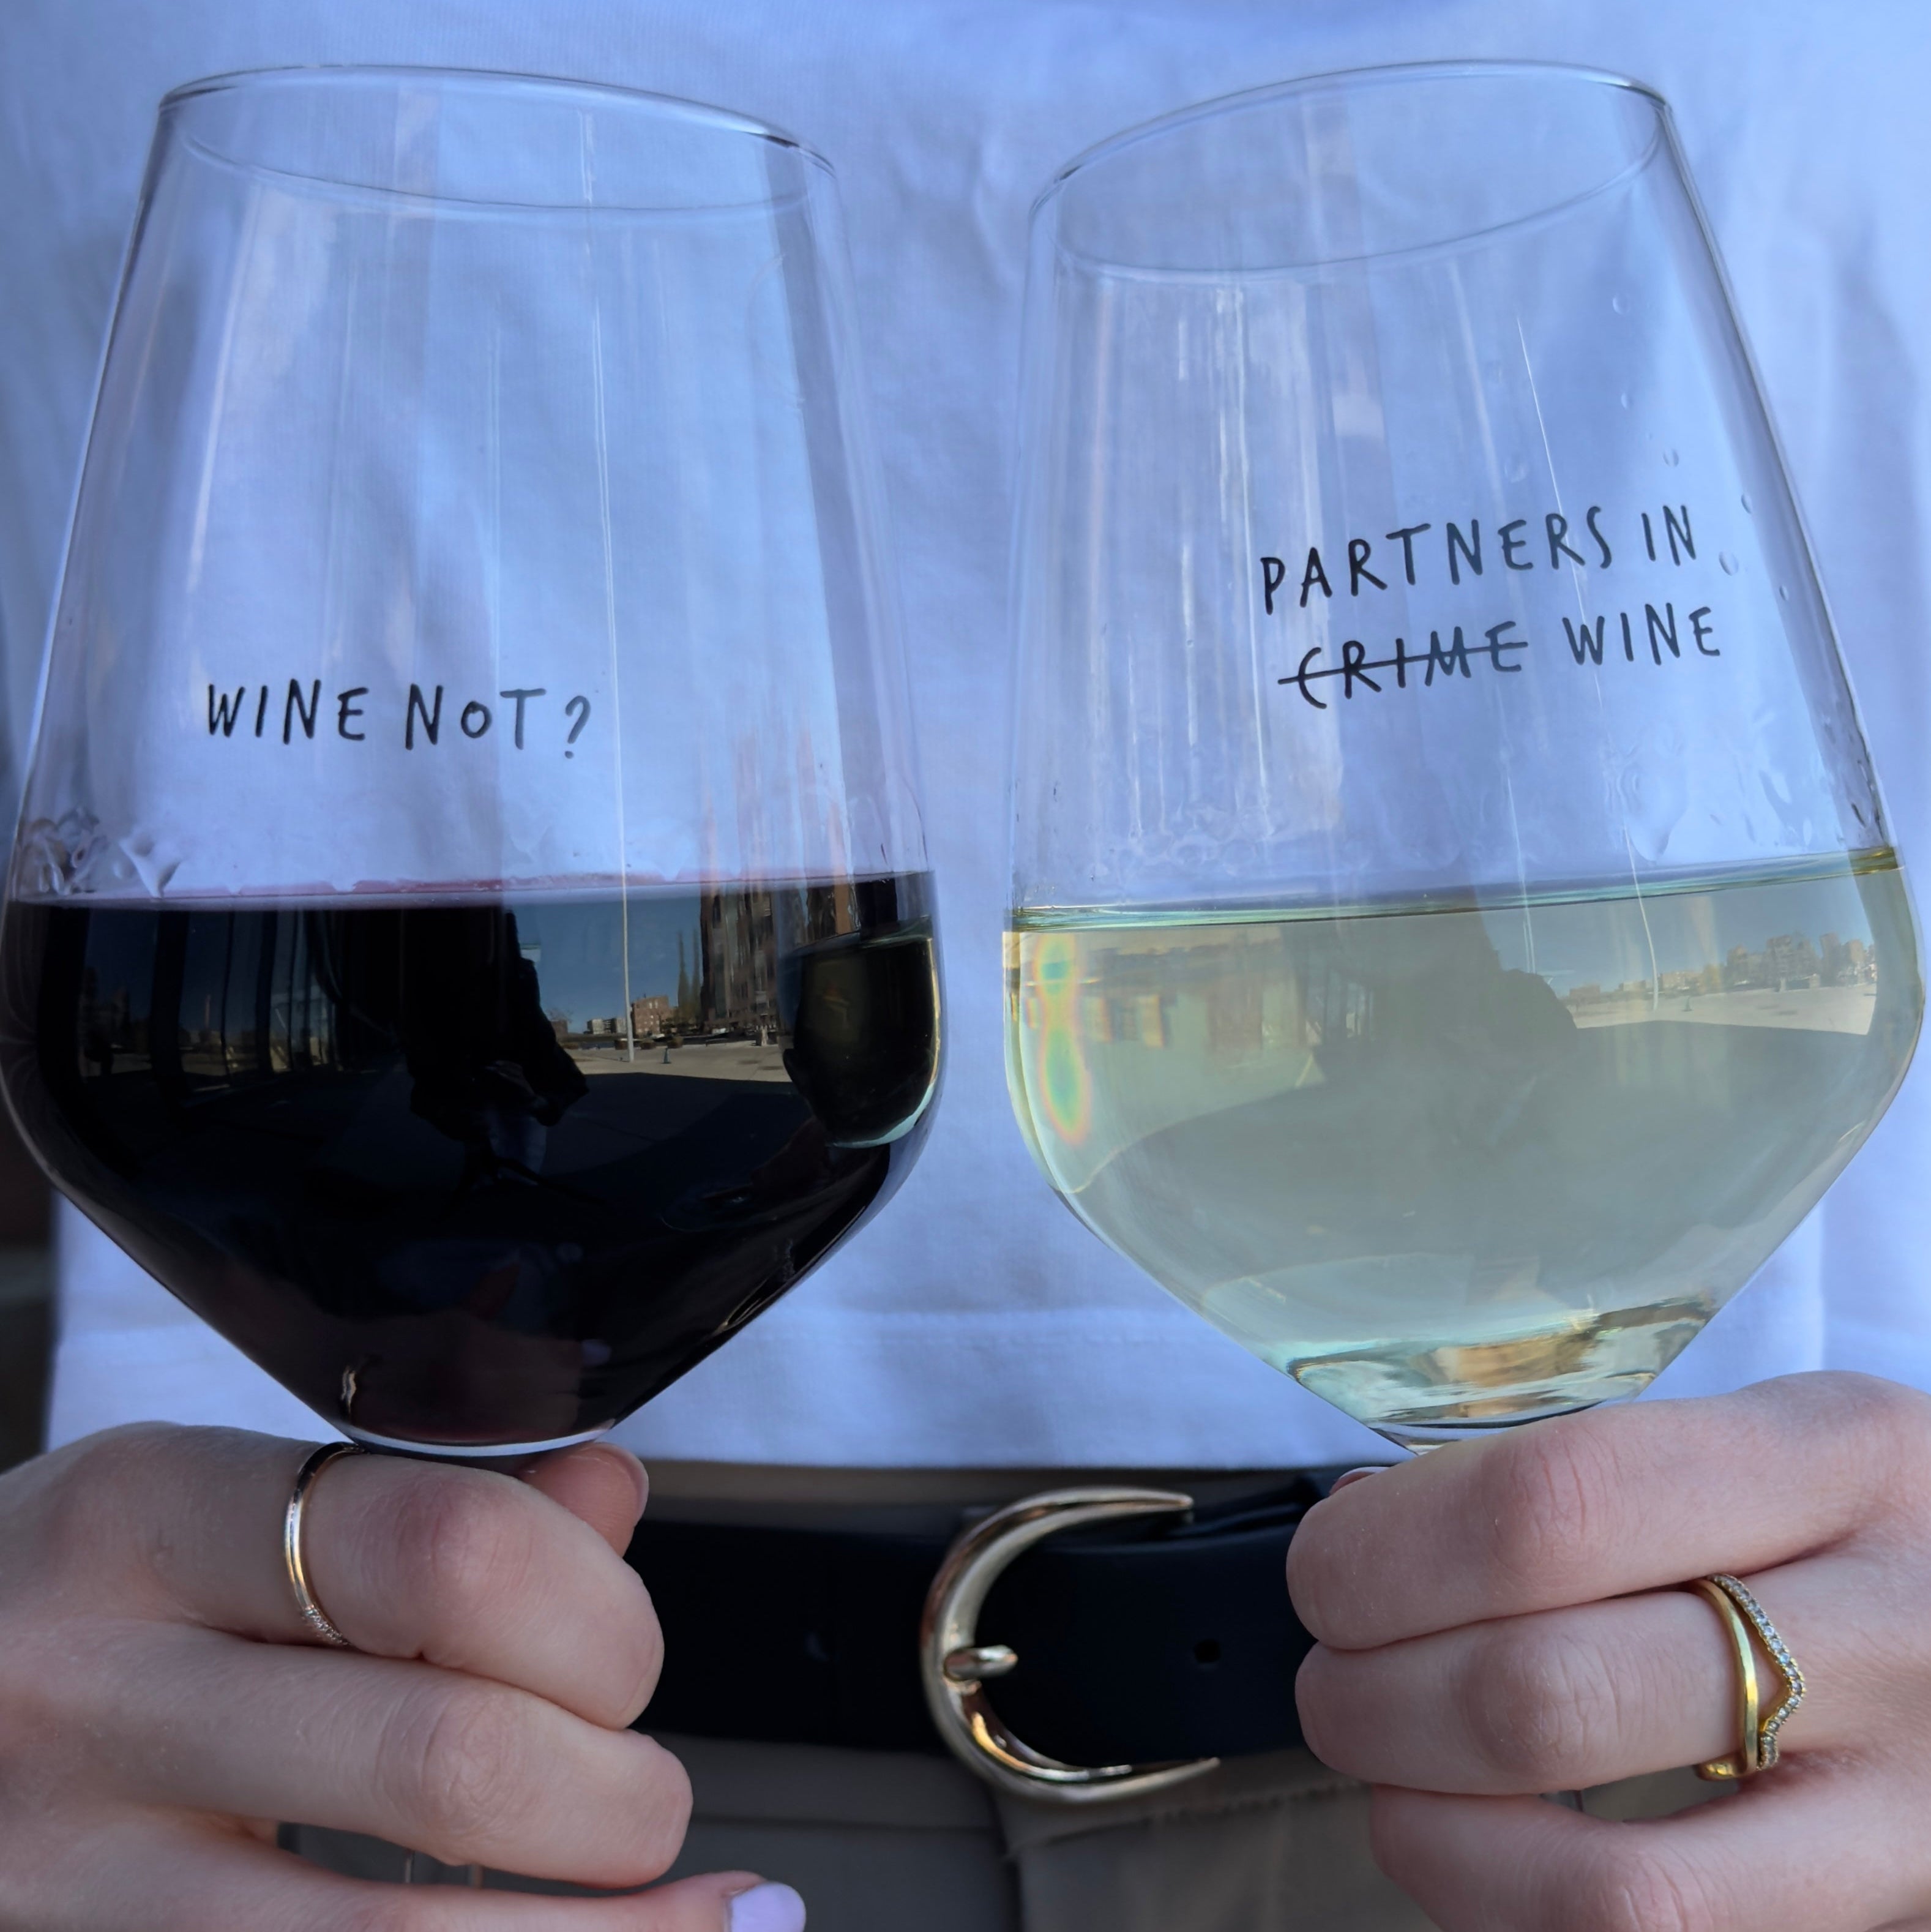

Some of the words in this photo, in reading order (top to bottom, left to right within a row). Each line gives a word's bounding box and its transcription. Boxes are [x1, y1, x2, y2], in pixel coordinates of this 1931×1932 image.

[1259, 505, 1613, 616] PARTNERS
[1640, 505, 1697, 567] IN
[1278, 621, 1529, 710] CRIME
[1561, 602, 1721, 666] WINE
[207, 678, 369, 745] WINE
